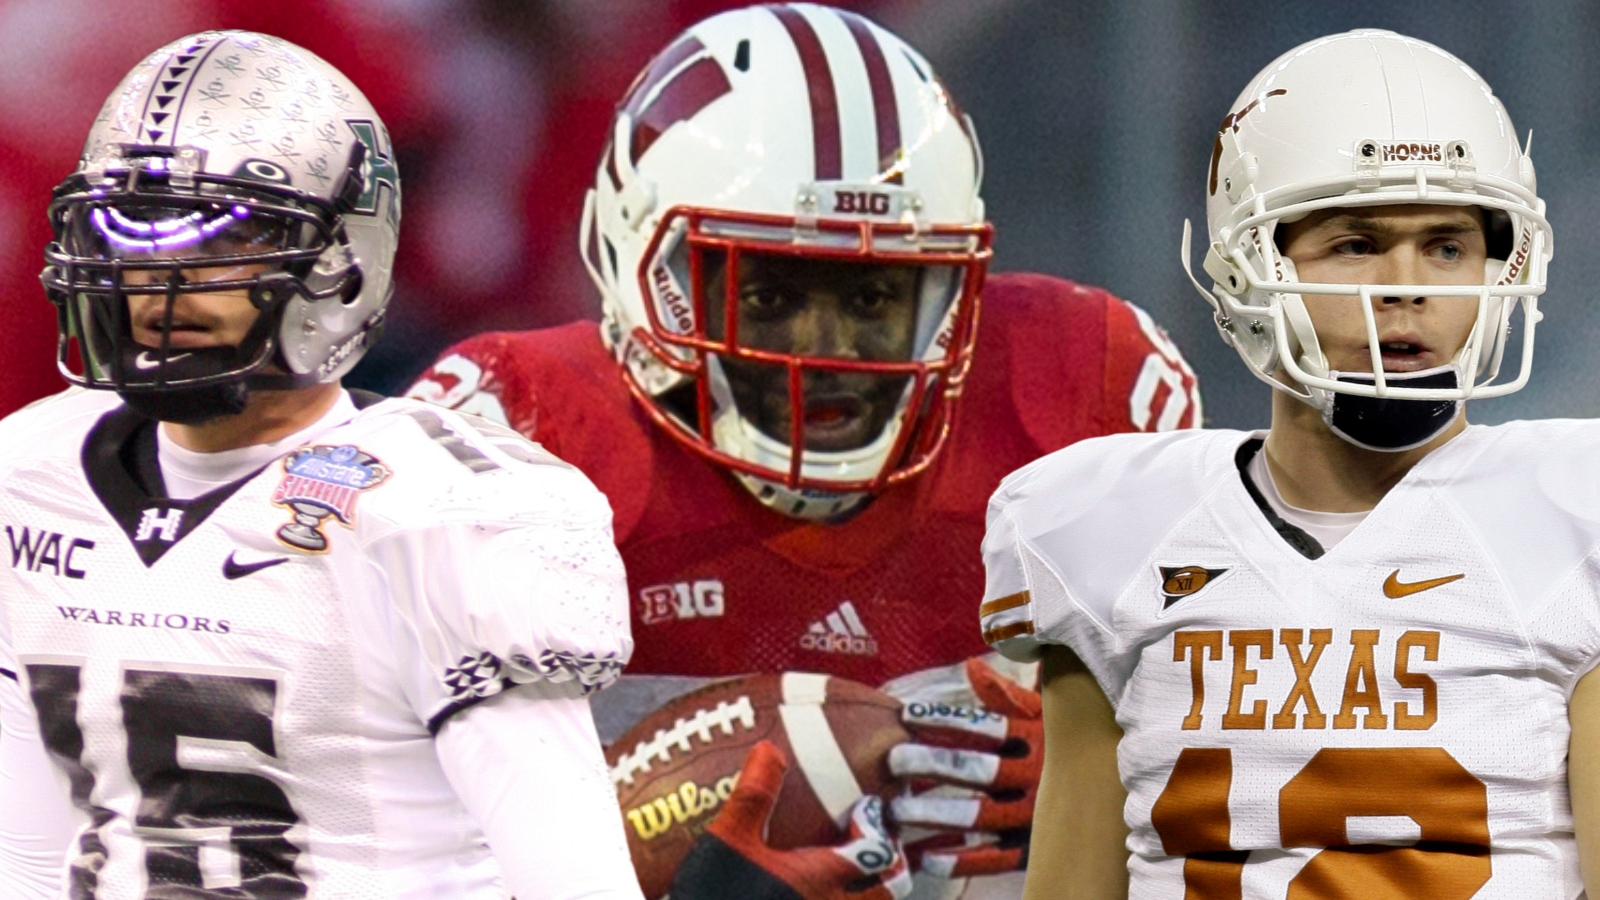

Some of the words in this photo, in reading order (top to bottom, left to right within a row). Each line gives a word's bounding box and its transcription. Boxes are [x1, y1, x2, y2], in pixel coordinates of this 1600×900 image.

[1382, 143, 1442, 162] HORNS
[653, 266, 693, 332] Ridde
[293, 457, 367, 486] Allstate
[135, 507, 186, 542] H
[5, 525, 95, 579] WAC
[1174, 578, 1193, 592] XII
[57, 606, 231, 634] WARRIORS
[1173, 628, 1441, 731] TEXAS
[20, 655, 310, 900] 15
[627, 771, 743, 840] Wilso
[1151, 747, 1492, 900] 12
